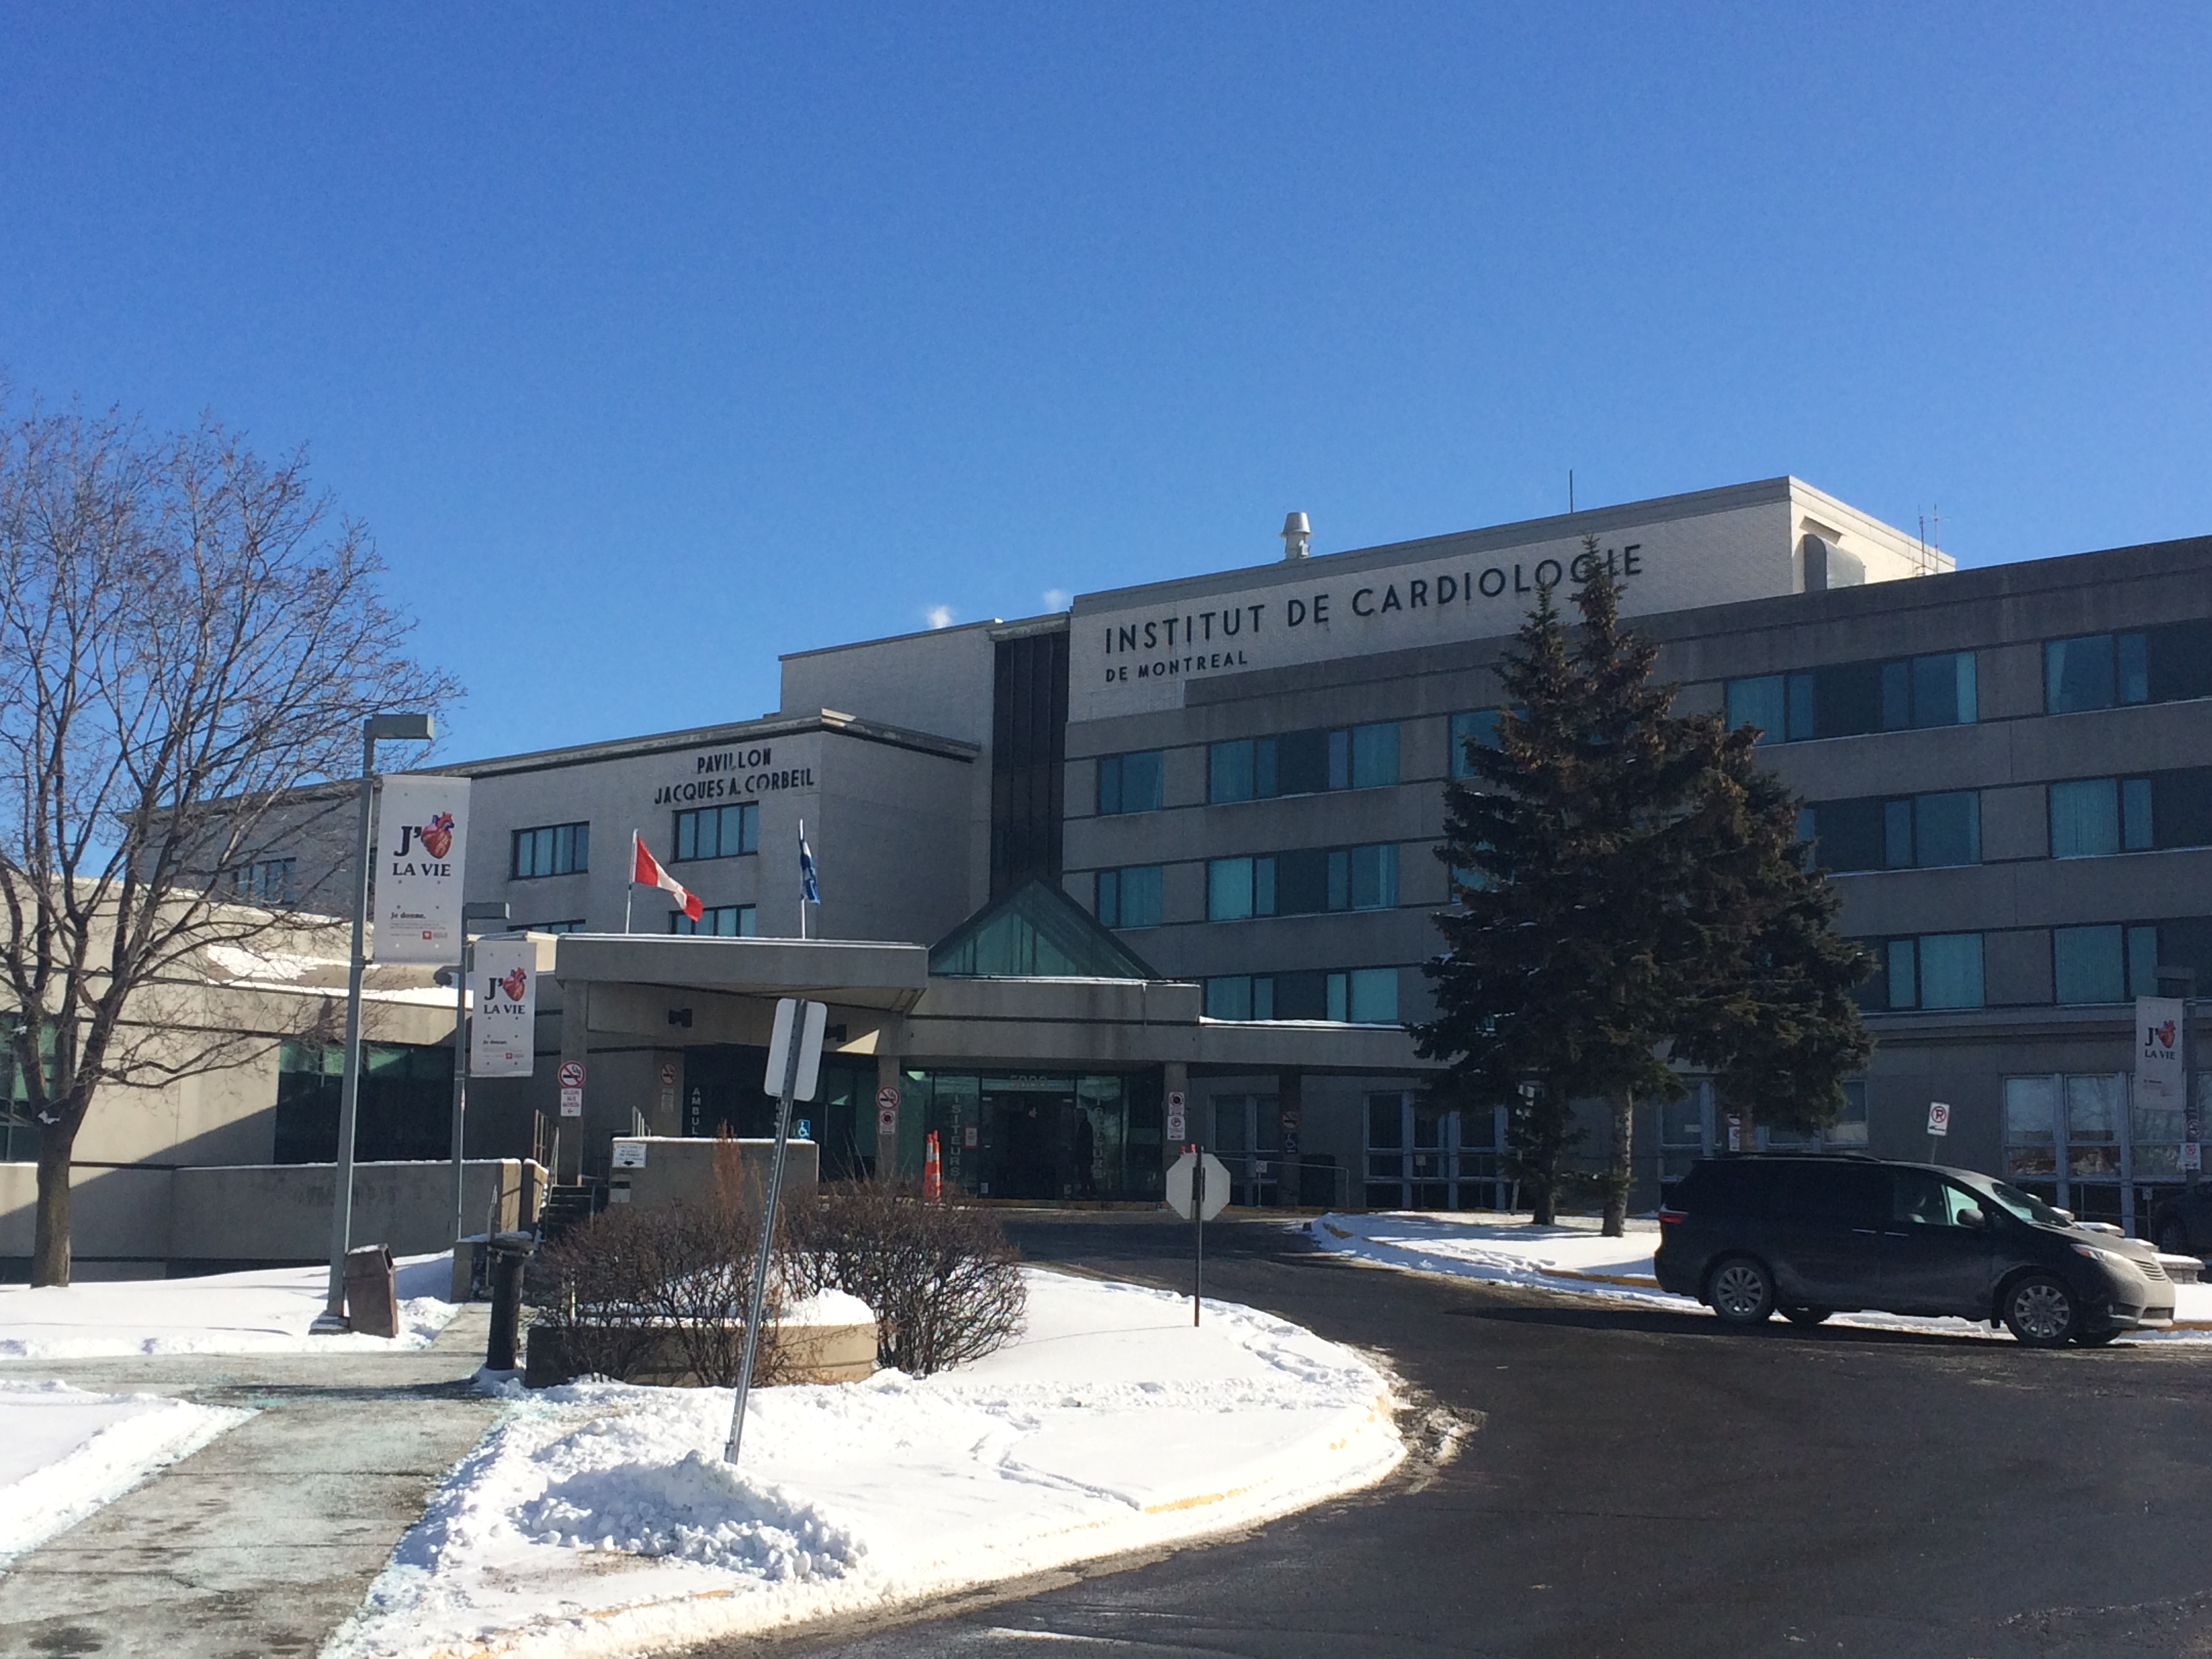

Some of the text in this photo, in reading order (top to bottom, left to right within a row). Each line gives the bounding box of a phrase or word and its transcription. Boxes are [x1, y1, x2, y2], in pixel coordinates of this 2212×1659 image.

[1105, 604, 1265, 654] INSTITUT
[1287, 594, 1330, 628] DE
[1105, 651, 1248, 682] DE MONTREAL
[697, 747, 772, 775] PAVILLON
[655, 778, 724, 805] JACQUES
[745, 767, 815, 794] CORBEIL
[392, 863, 451, 877] LA VIE
[483, 1004, 526, 1015] LA VIE
[2144, 1048, 2175, 1060] LA VIE
[949, 1091, 962, 1177] ISITEURS
